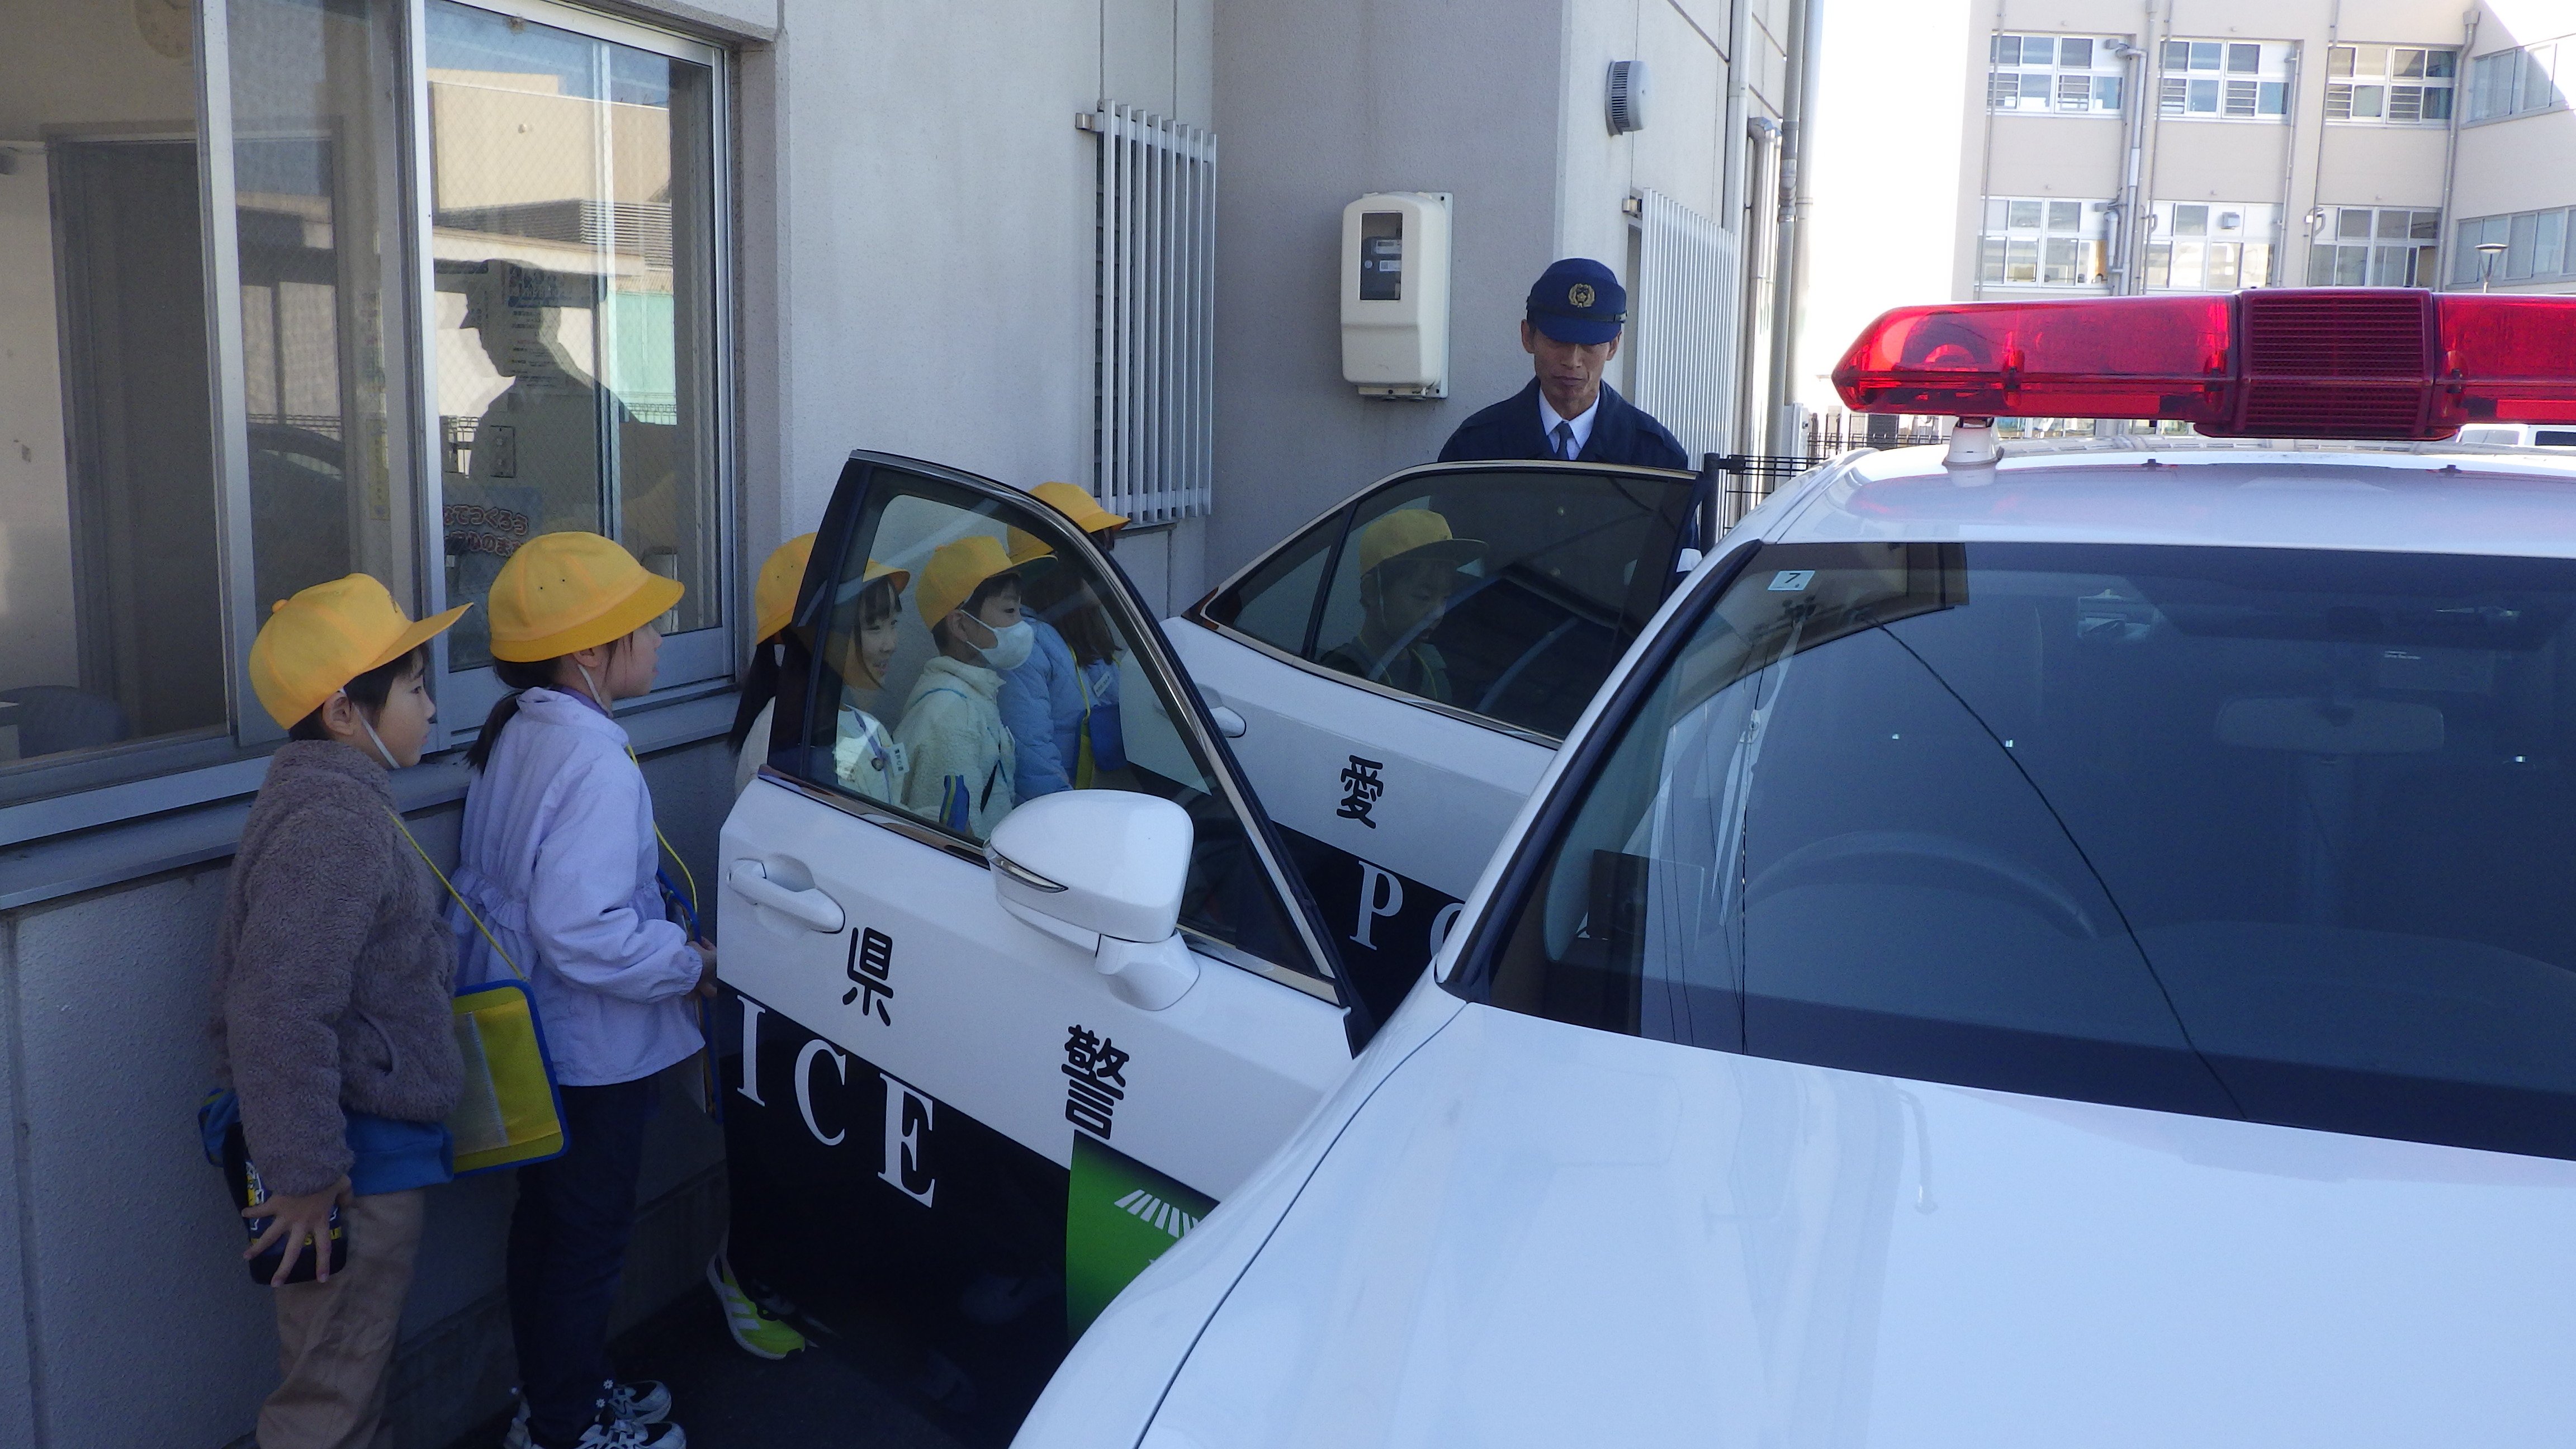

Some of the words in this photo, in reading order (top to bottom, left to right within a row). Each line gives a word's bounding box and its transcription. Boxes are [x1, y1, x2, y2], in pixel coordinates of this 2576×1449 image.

[1784, 572, 1801, 584] 7
[1336, 755, 1384, 829] 愛
[737, 994, 935, 1208] ICE
